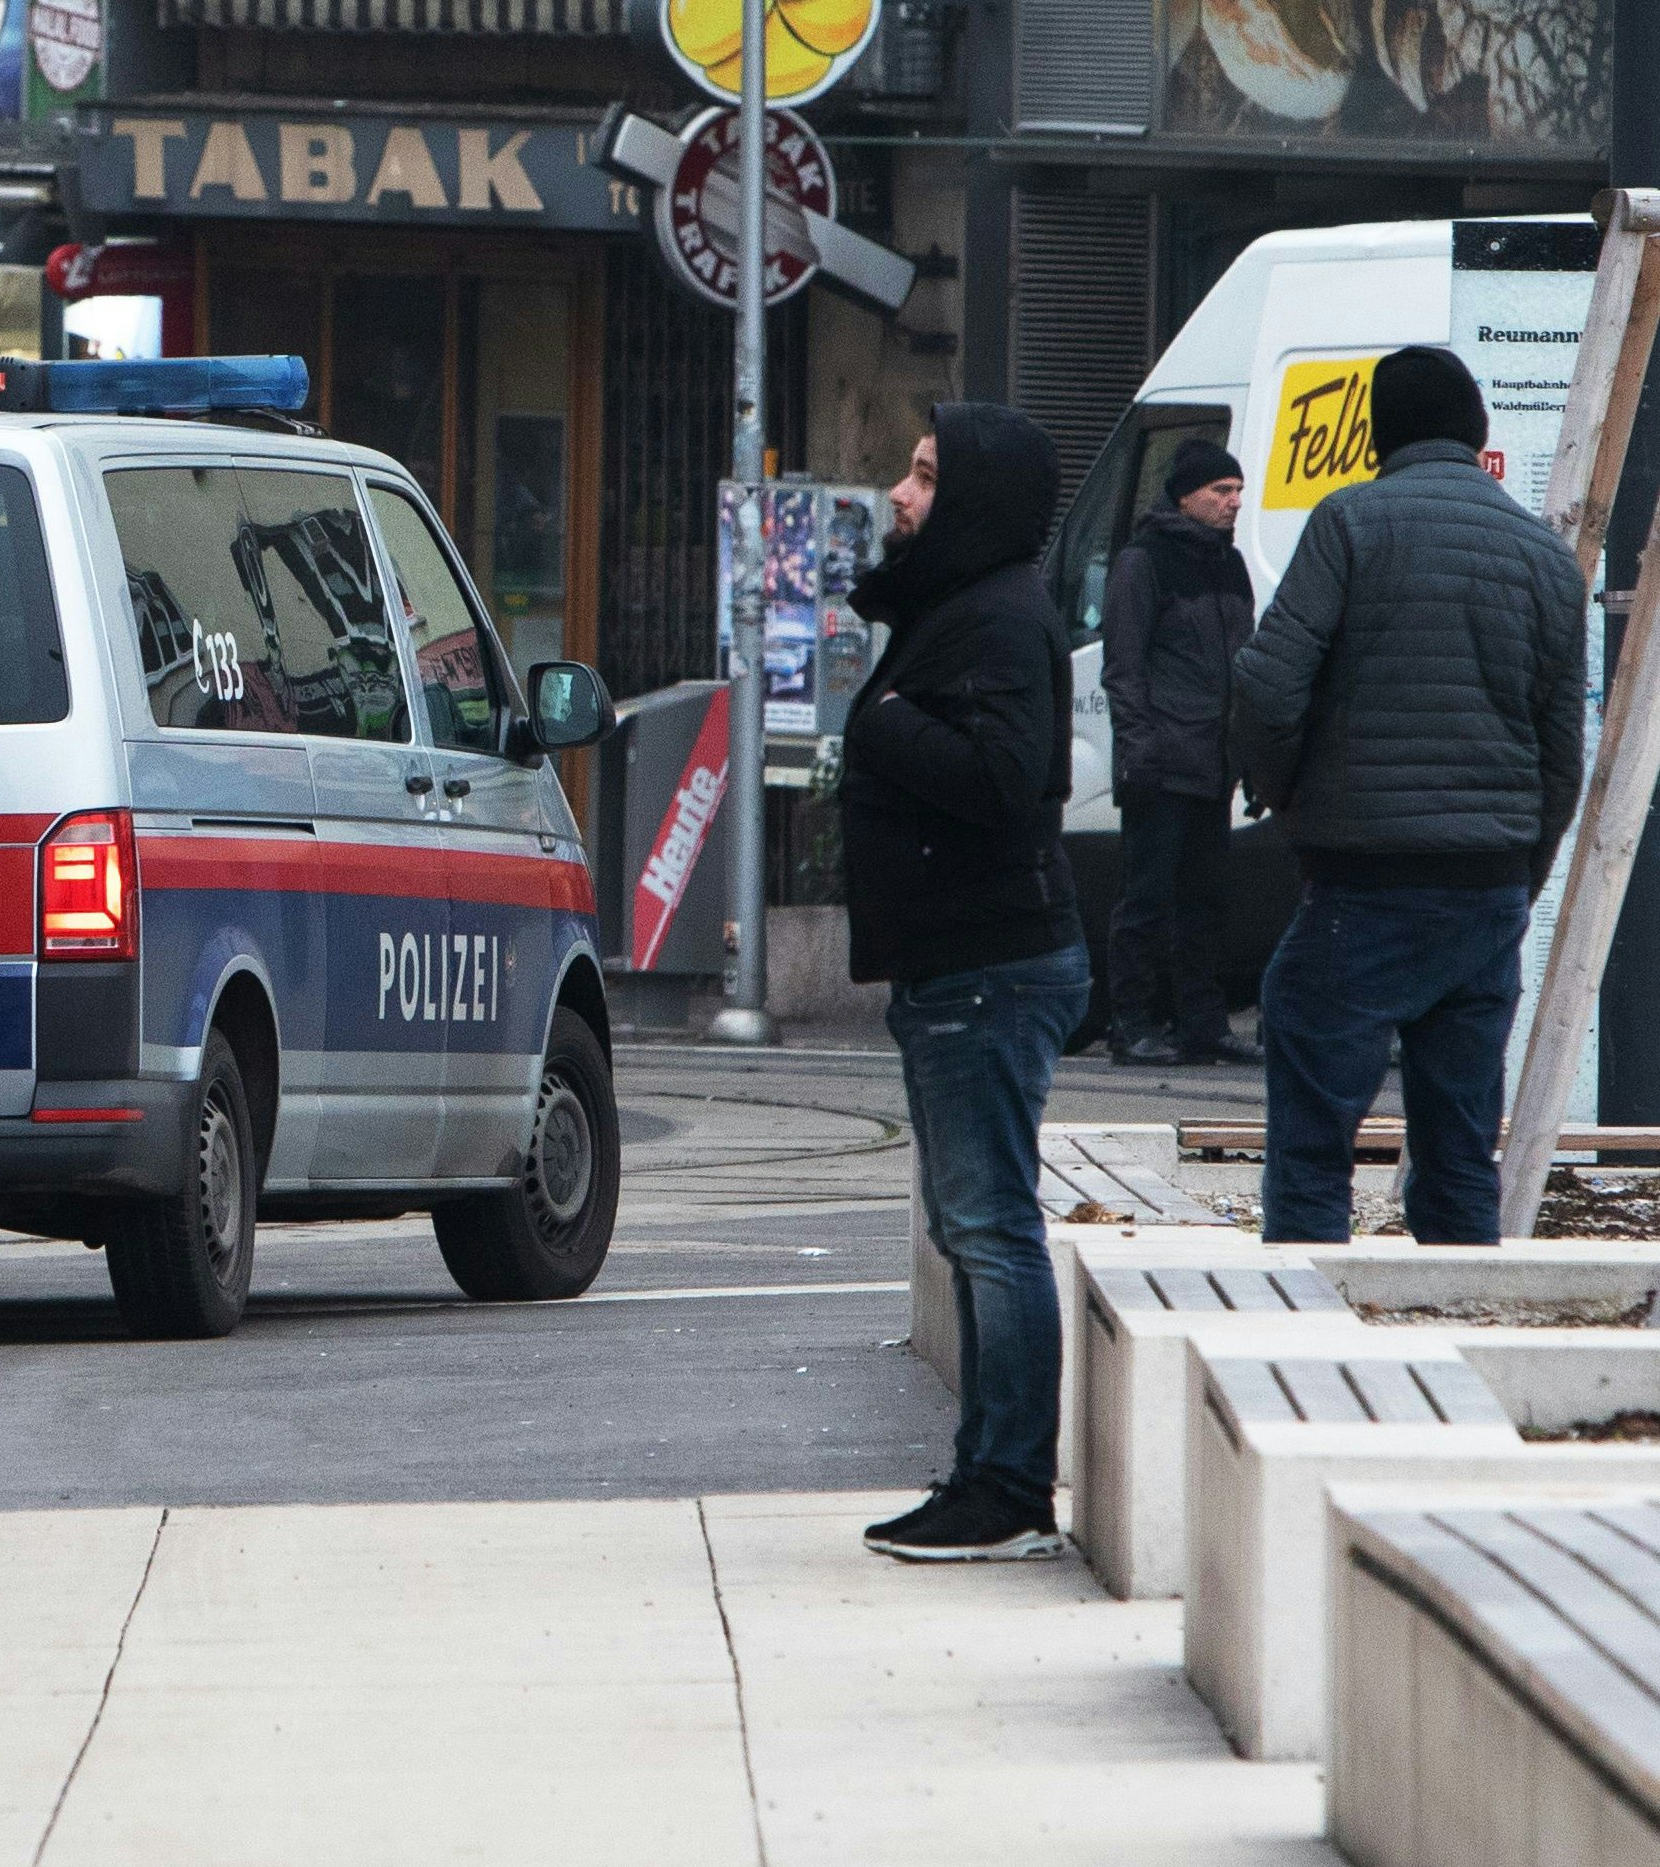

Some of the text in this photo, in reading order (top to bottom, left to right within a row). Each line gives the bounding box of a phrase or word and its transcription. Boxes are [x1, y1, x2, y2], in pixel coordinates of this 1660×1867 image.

[112, 119, 543, 211] TABAK
[674, 191, 791, 292] TRAFK
[1479, 326, 1584, 344] Reumann
[205, 632, 244, 700] 133
[641, 765, 719, 901] Heute
[379, 931, 498, 1022] POLIZEI
